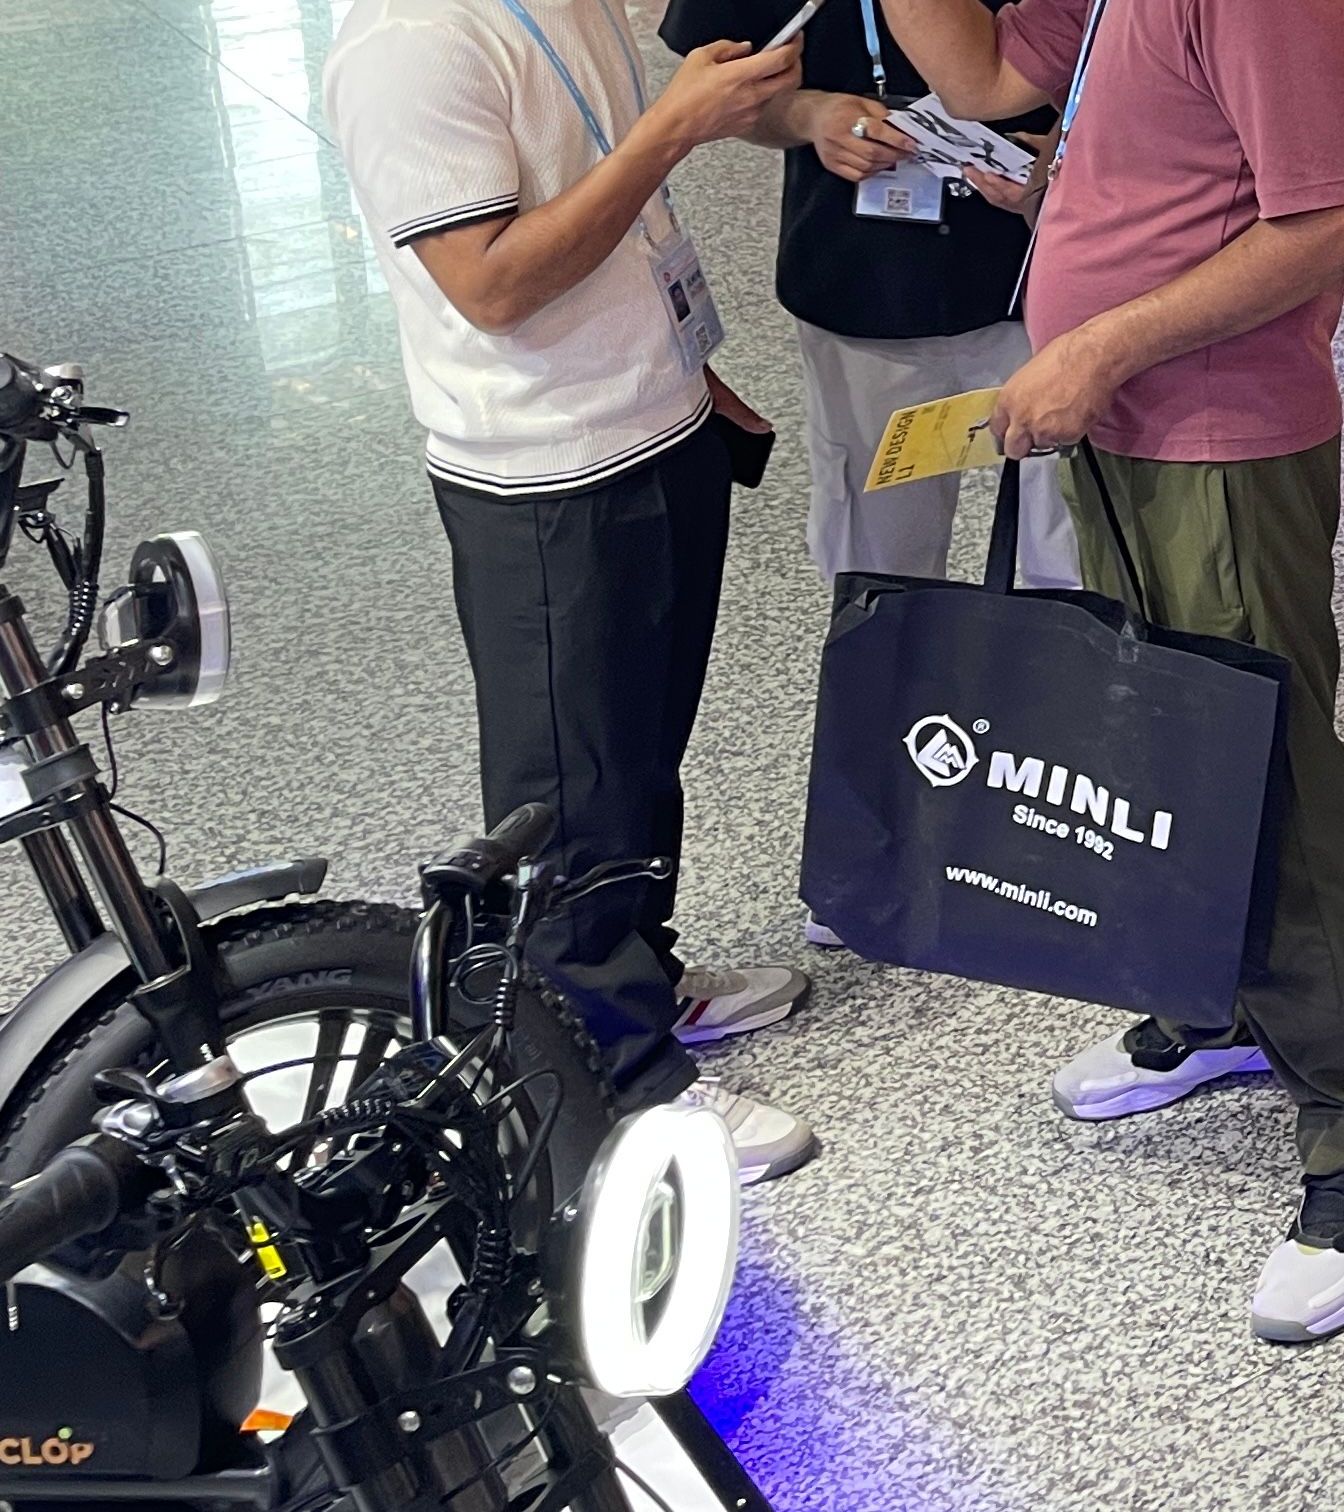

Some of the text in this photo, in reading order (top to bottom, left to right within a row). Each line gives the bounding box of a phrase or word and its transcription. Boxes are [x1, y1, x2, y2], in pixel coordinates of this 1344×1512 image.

[876, 410, 917, 485] NEW DESIGN
[986, 750, 1174, 850] MINLI
[1012, 803, 1114, 862] Since 1992
[946, 865, 1098, 927] www.minli.com
